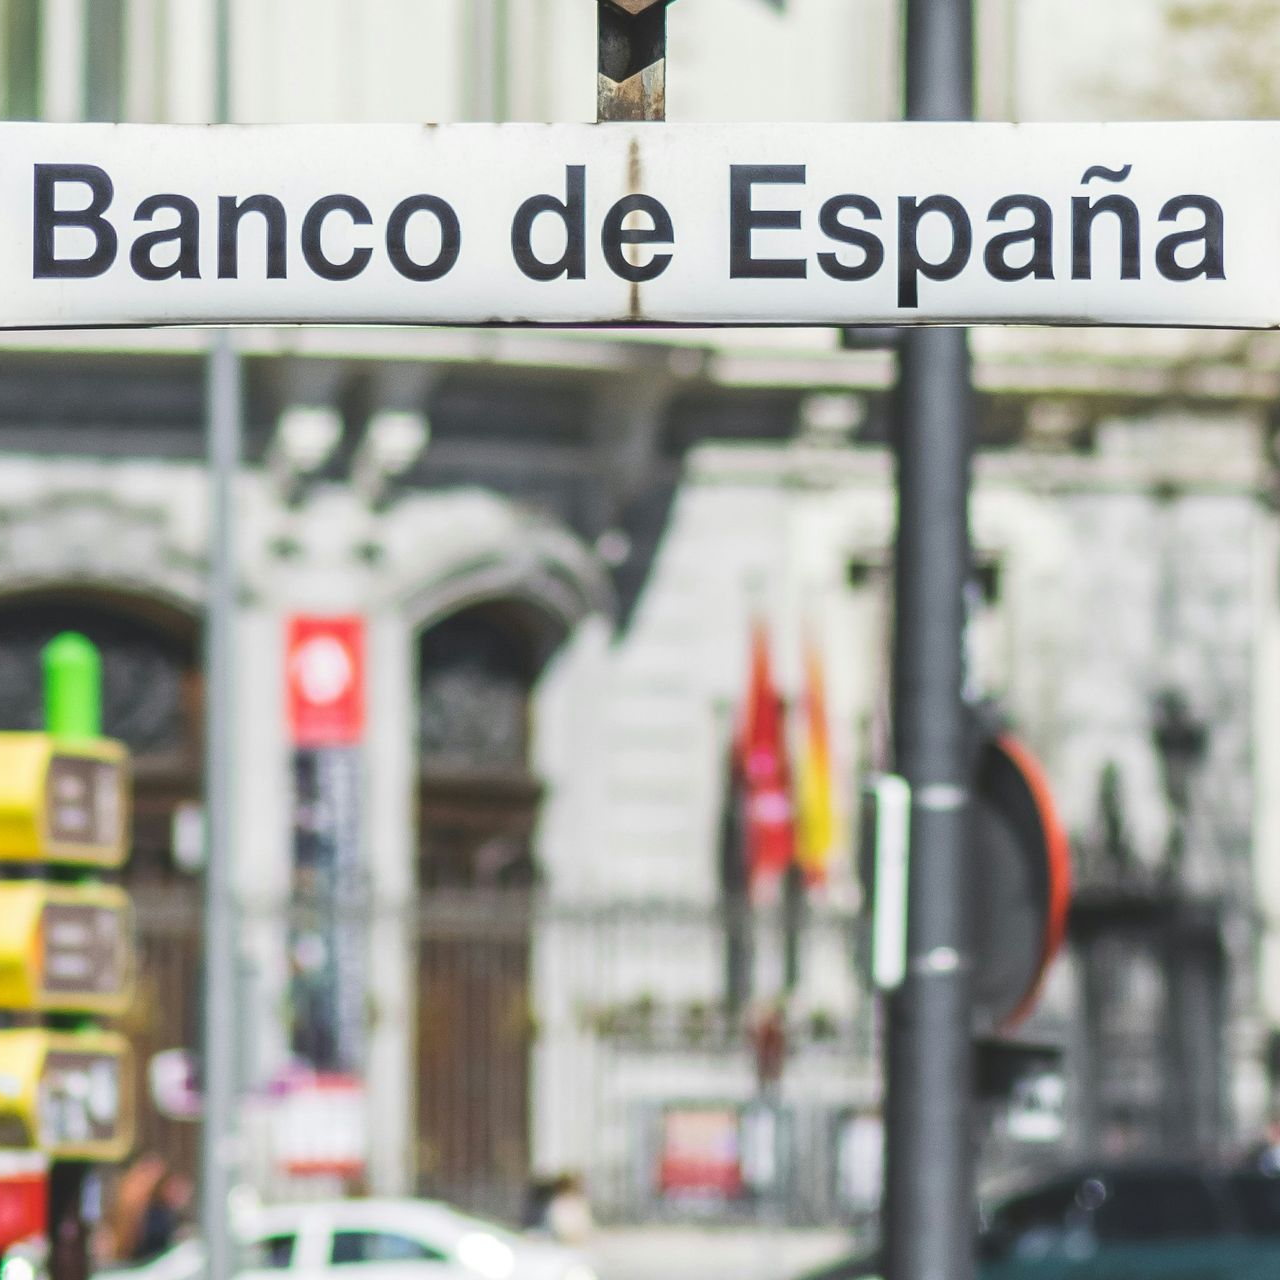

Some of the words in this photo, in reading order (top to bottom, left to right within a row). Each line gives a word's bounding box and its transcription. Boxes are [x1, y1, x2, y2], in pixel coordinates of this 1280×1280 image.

[31, 163, 462, 283] Banco
[510, 163, 676, 283] de
[728, 163, 1228, 309] España
